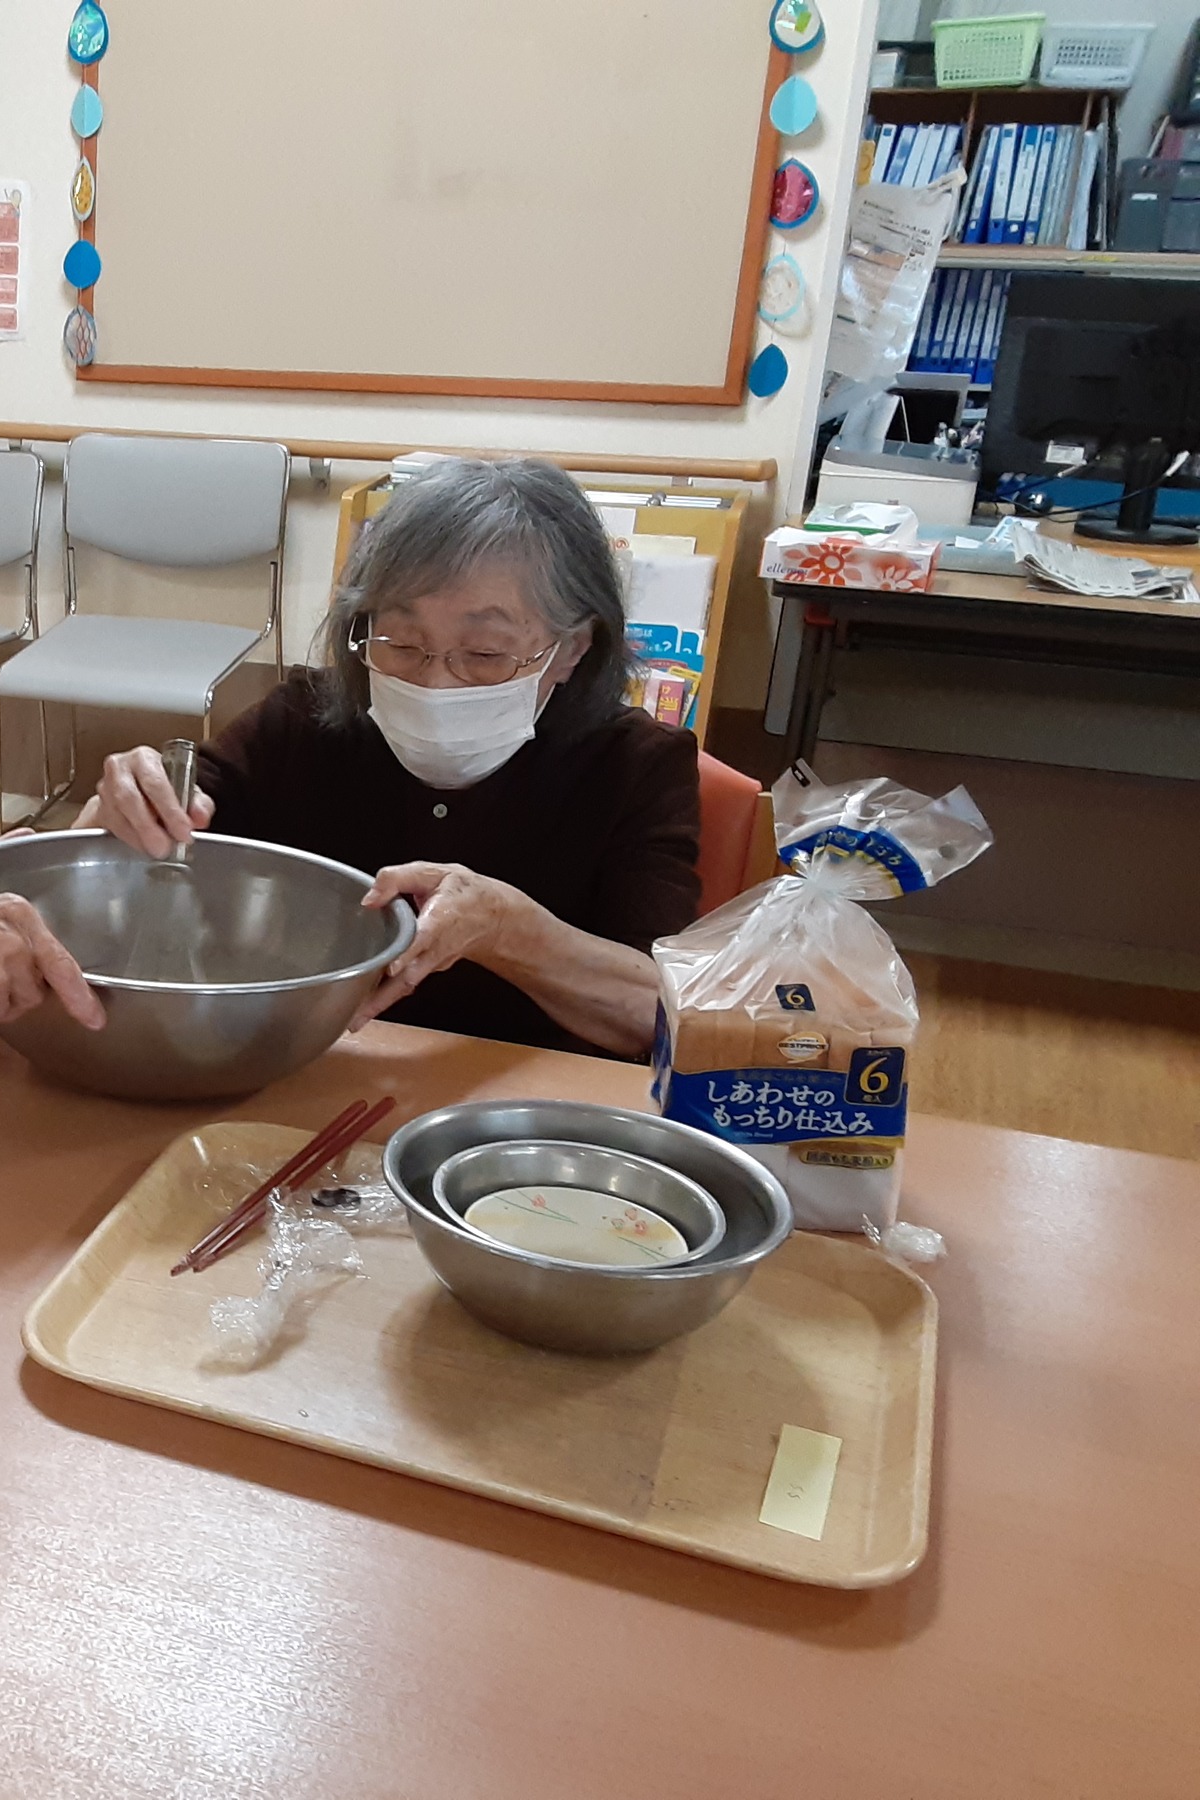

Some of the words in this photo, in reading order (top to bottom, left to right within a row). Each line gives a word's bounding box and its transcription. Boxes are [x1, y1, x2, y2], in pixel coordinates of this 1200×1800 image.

[785, 988, 805, 1006] 6
[859, 1056, 890, 1094] 6
[707, 1080, 836, 1107] しあわせの
[712, 1105, 875, 1135] もっちり仕込み
